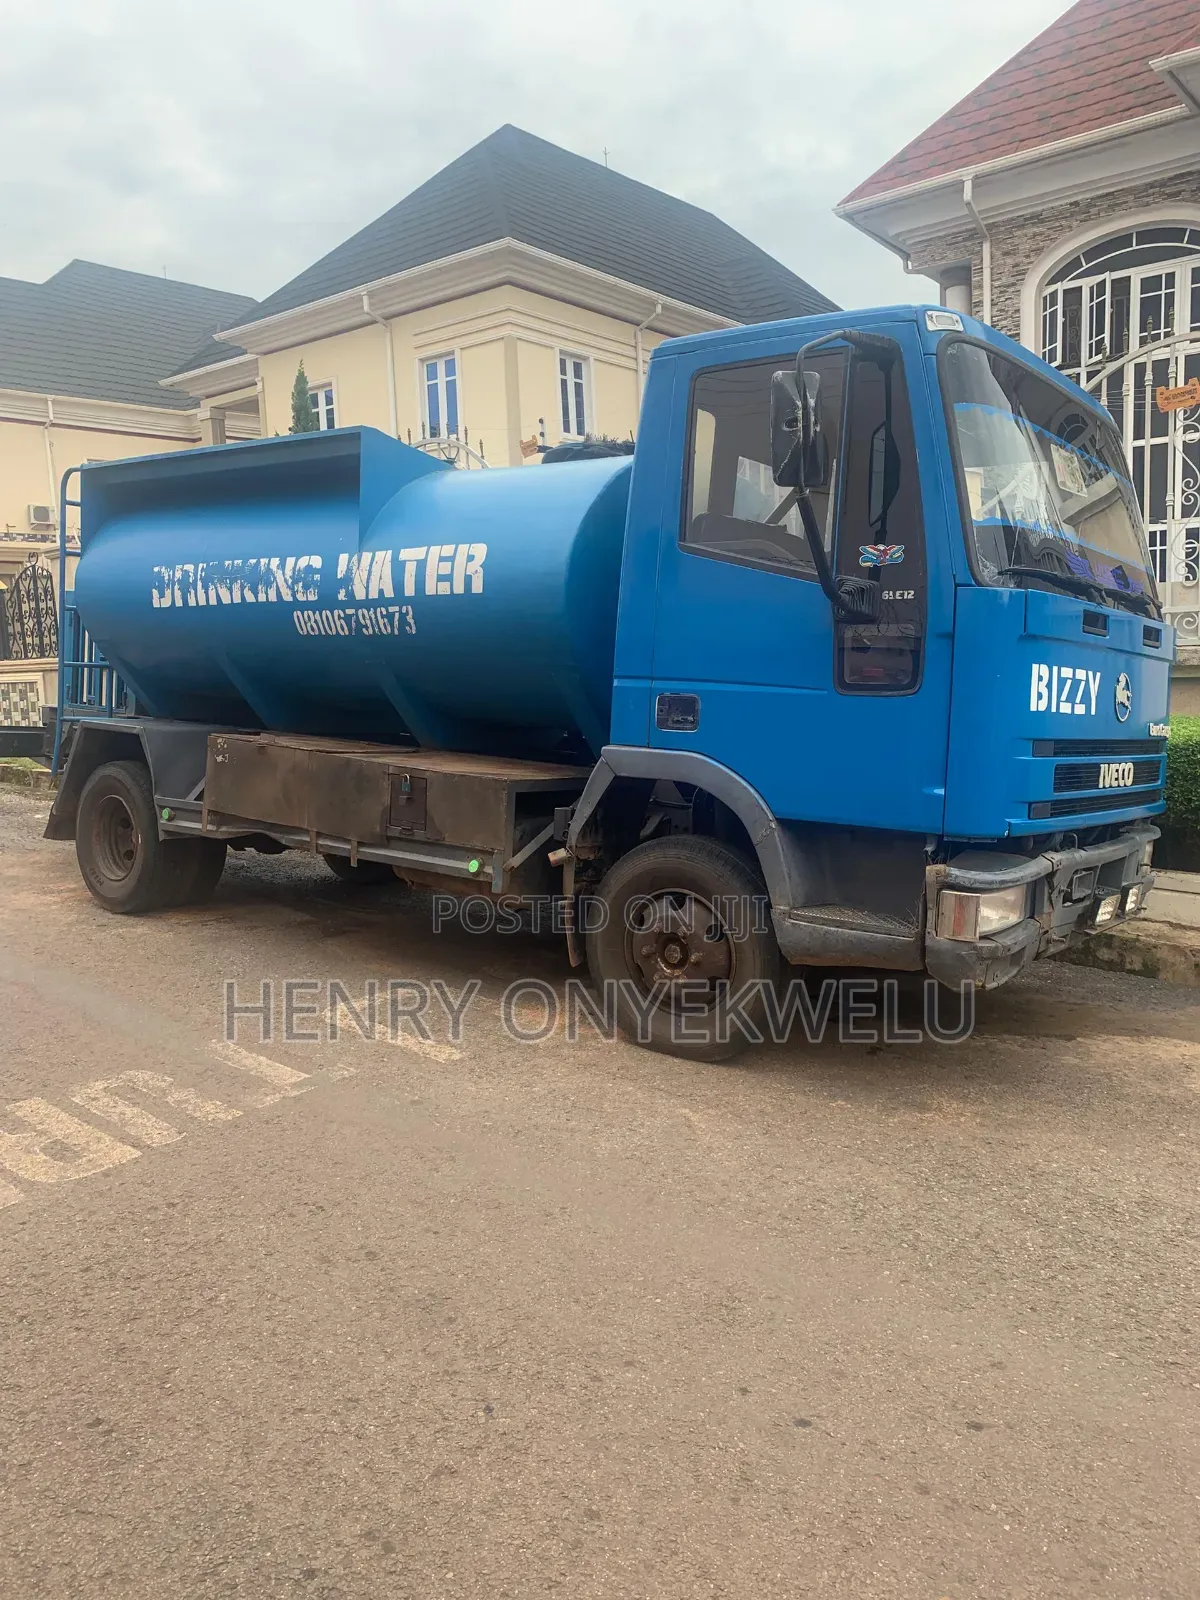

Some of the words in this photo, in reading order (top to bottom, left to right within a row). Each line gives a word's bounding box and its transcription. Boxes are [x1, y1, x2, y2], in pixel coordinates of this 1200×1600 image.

[337, 542, 488, 601] WATER
[293, 604, 416, 636] 08106791673
[1029, 663, 1101, 716] BIZZY
[1098, 762, 1135, 789] IVECO
